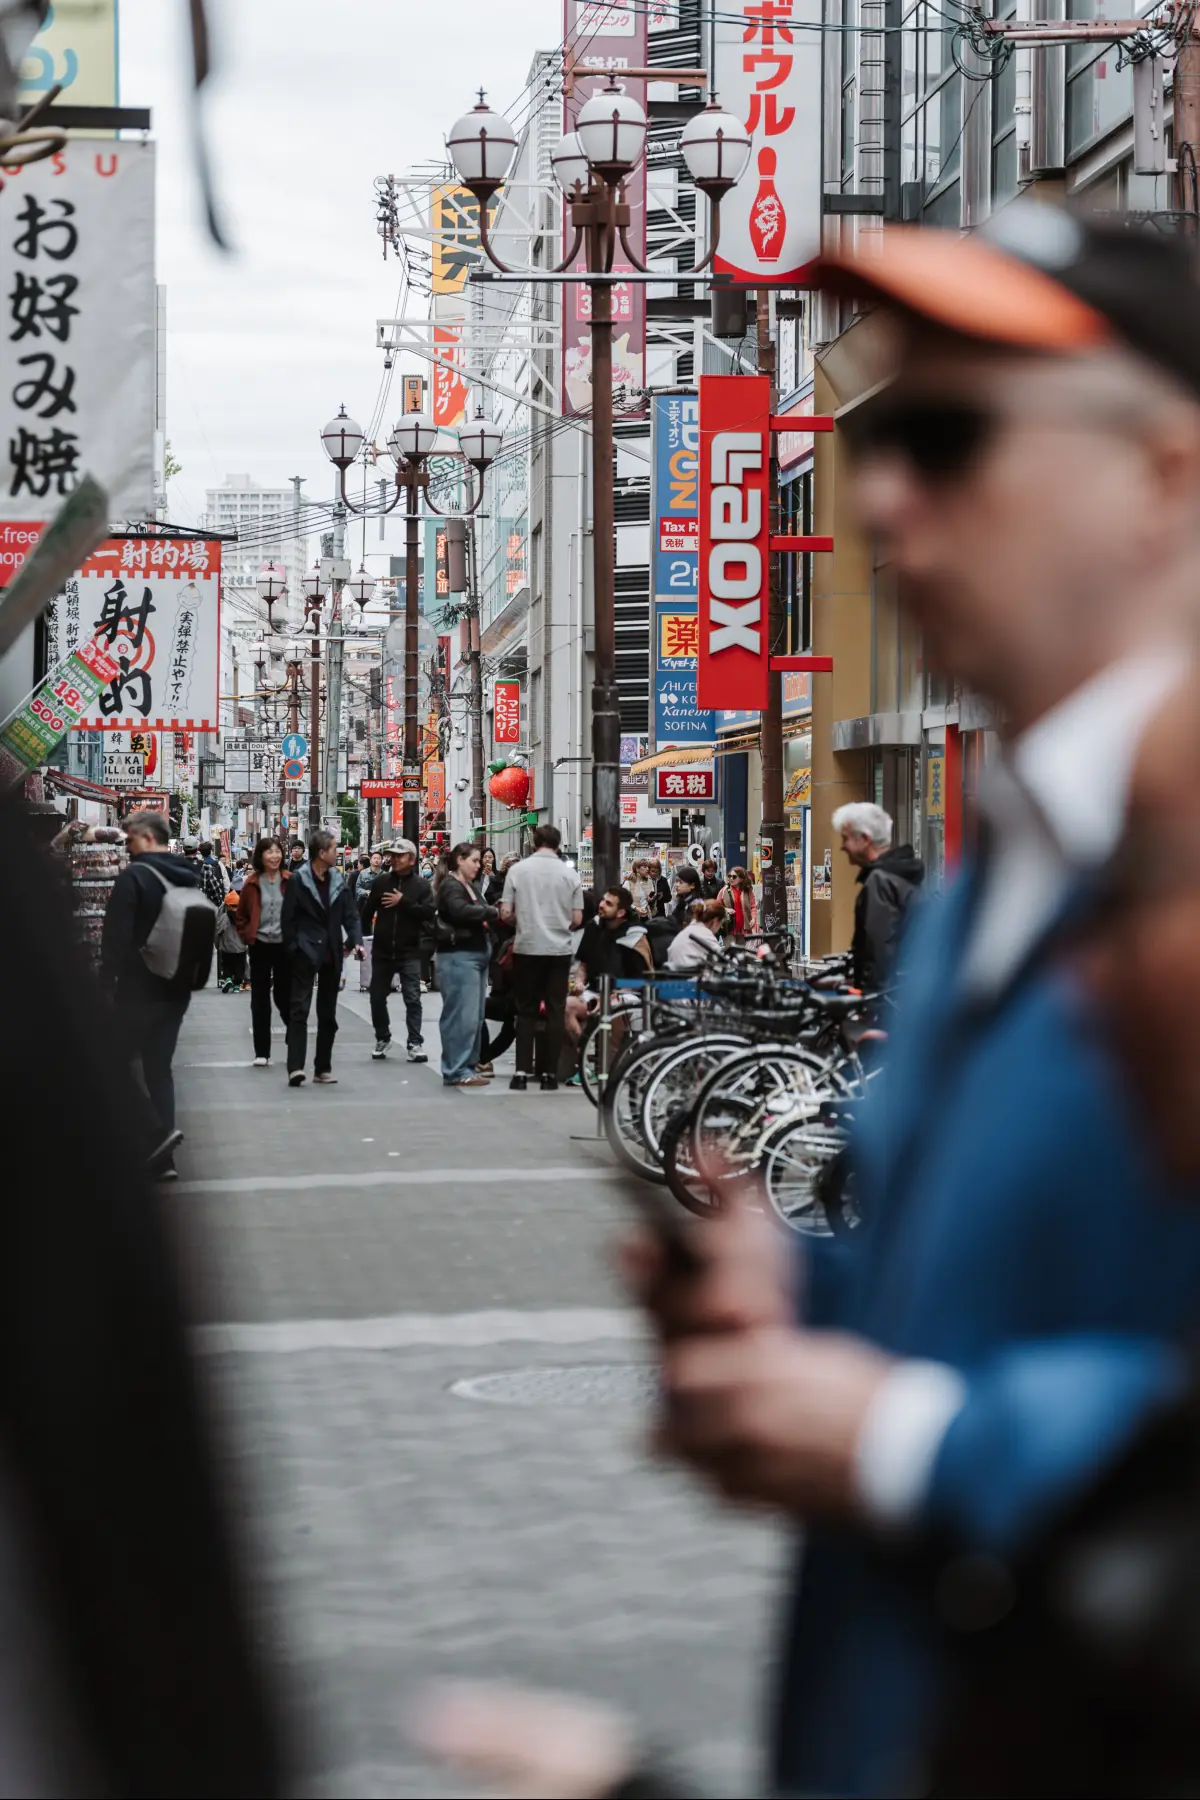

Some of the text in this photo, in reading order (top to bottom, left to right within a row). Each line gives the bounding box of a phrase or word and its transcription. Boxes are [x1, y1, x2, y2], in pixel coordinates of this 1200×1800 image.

[581, 14, 631, 27] ダイニング
[8, 193, 82, 498] お好み焼
[668, 400, 681, 448] エディオン
[663, 522, 685, 533] Tax
[85, 540, 209, 571] 一射的場
[665, 539, 684, 548] 免税
[93, 579, 157, 717] 射的
[667, 616, 698, 656] 薬
[658, 681, 698, 691] SHISE
[496, 687, 507, 738] ストロベリー
[508, 699, 519, 728] マニア
[665, 721, 708, 731] SOFINA
[362, 781, 403, 789] ツルハドラッ
[665, 774, 707, 795] 免税
